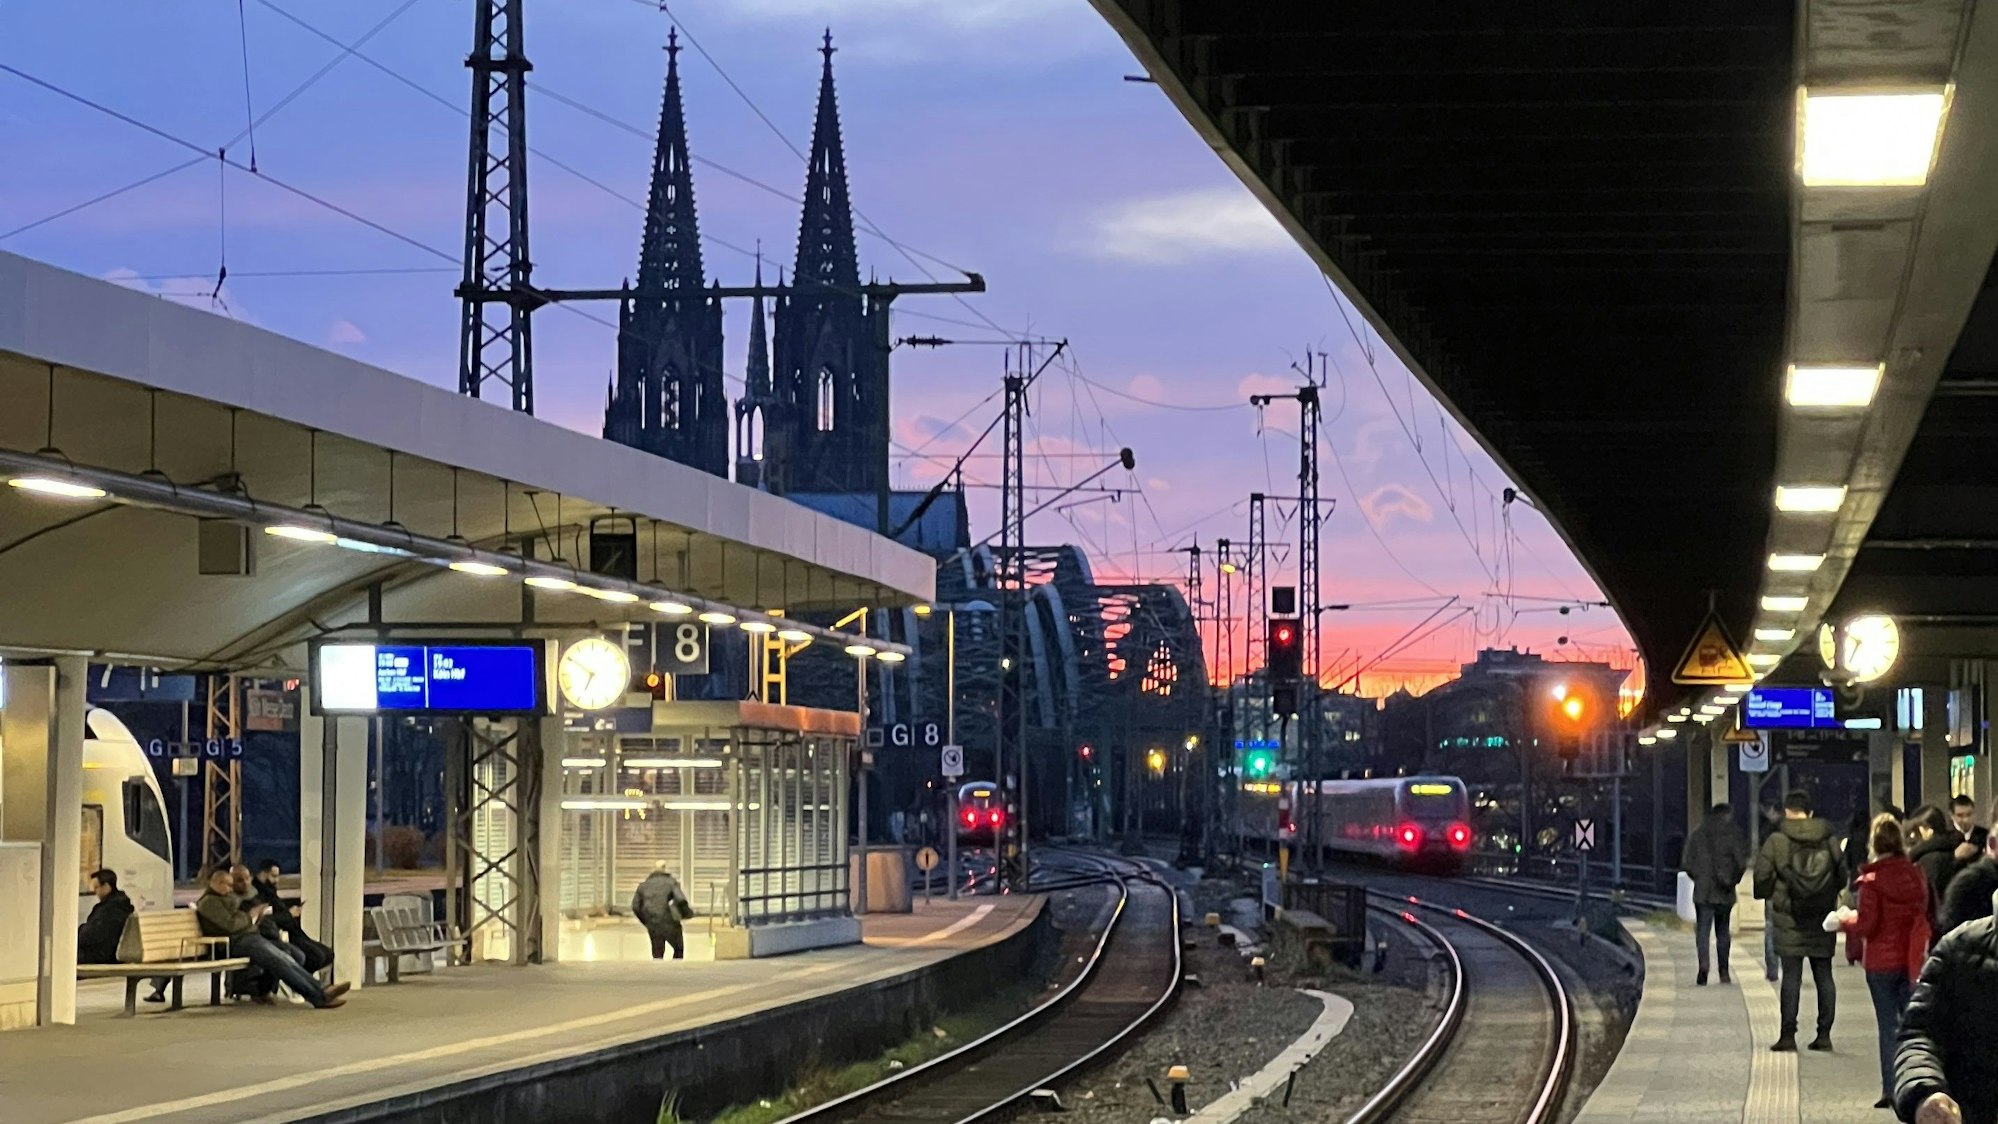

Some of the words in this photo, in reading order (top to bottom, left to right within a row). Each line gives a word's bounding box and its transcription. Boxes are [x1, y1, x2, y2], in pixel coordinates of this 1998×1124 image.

[674, 623, 700, 663] 8
[924, 723, 939, 746] 8
[149, 739, 163, 756] G
[231, 741, 243, 756] 5
